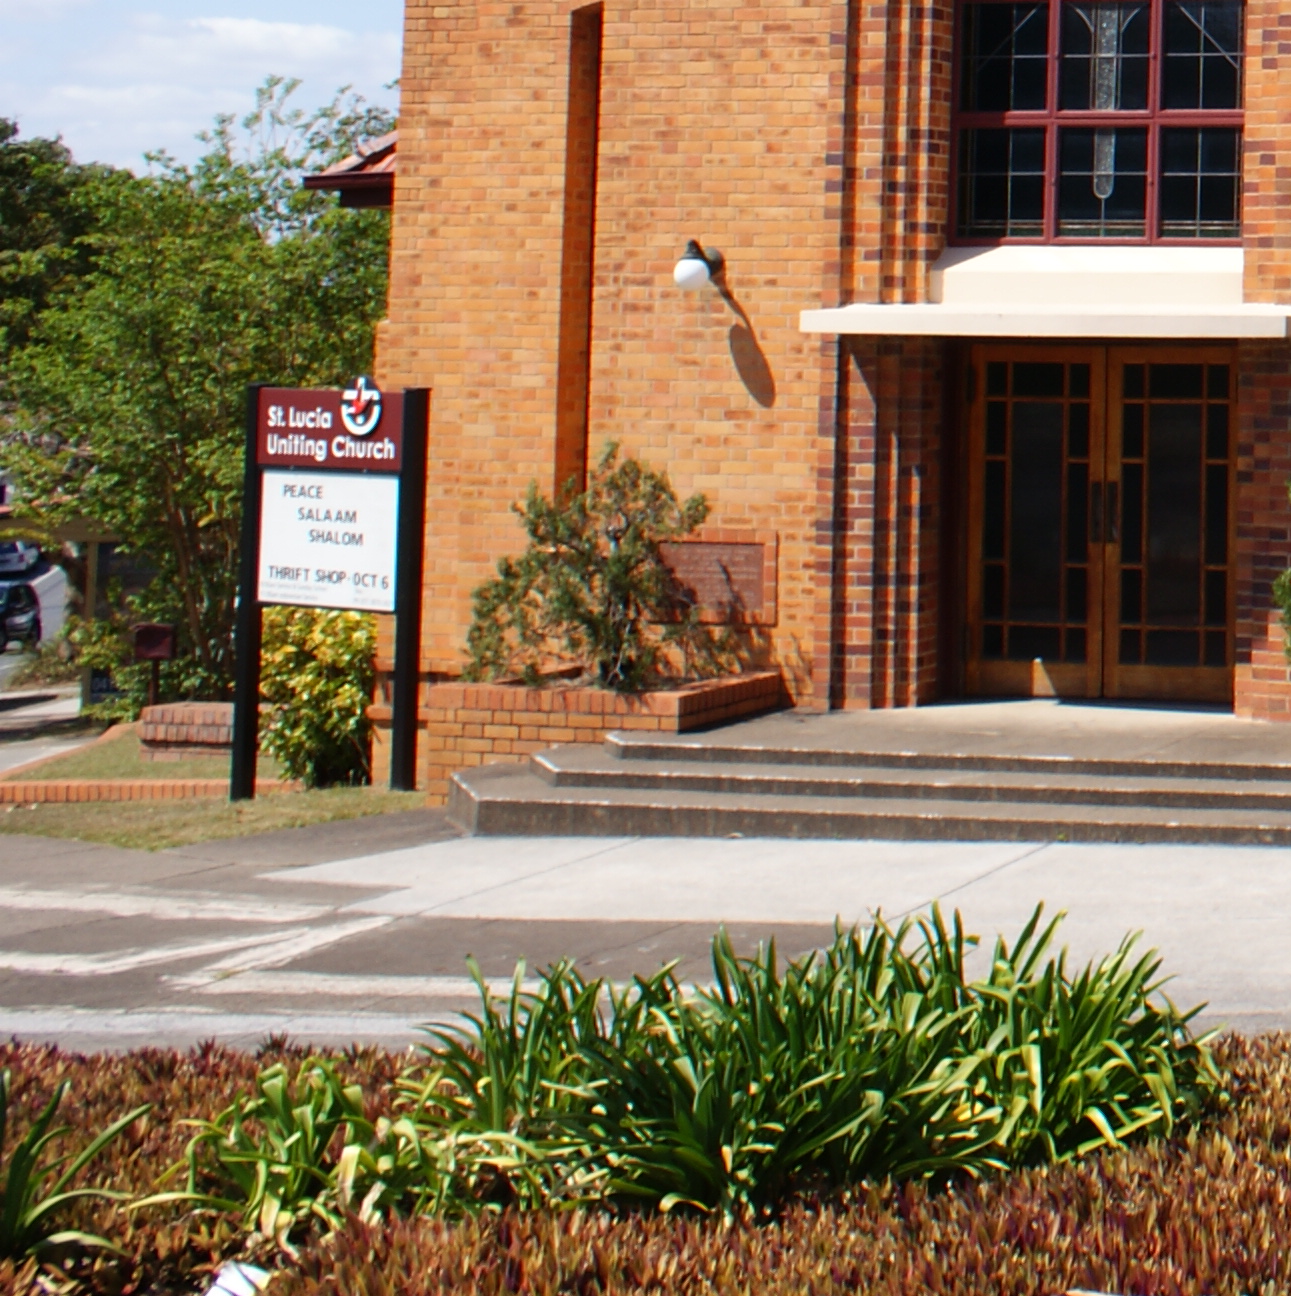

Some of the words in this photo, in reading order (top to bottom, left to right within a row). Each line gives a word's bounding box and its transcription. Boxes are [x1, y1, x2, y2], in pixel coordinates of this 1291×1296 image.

[267, 405, 286, 428] St.
[288, 406, 333, 429] Lucia
[267, 432, 328, 462] Uniting
[331, 435, 396, 460] Church
[282, 483, 323, 499] PEACE
[297, 506, 358, 524] SALAAM
[308, 528, 364, 546] SHALOM
[268, 565, 310, 582] THRIFT
[381, 574, 390, 590] 6
